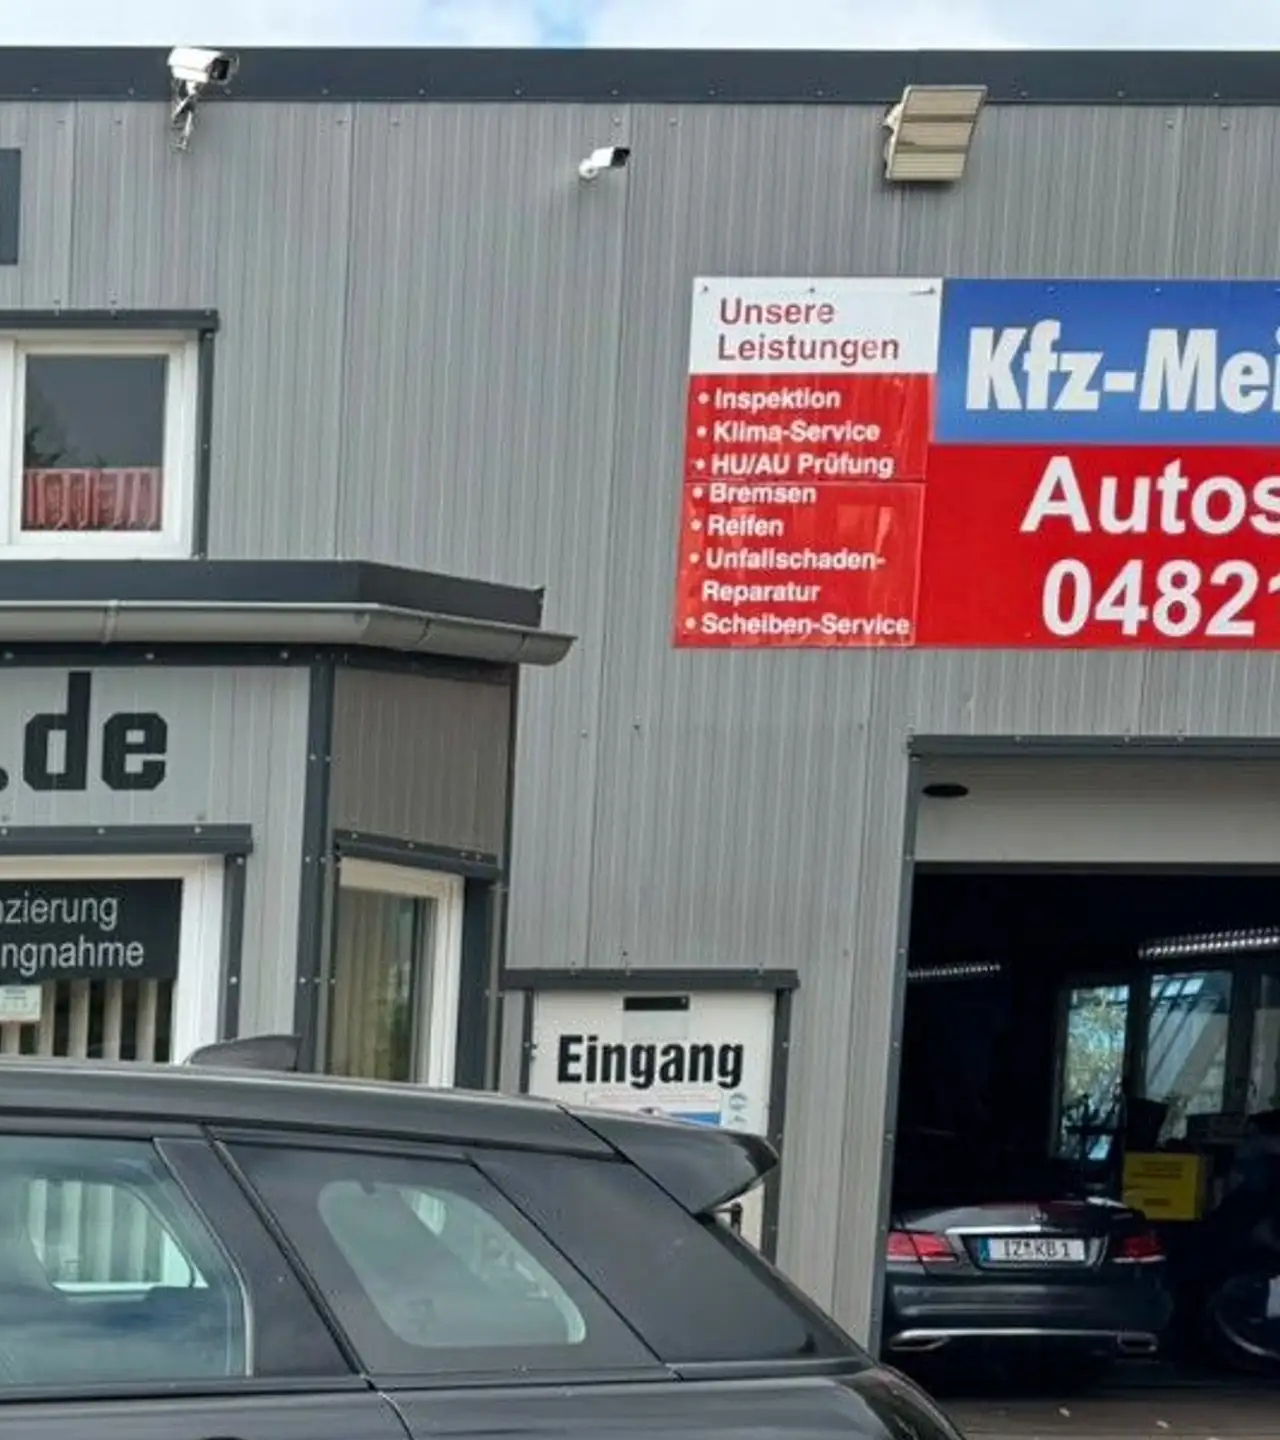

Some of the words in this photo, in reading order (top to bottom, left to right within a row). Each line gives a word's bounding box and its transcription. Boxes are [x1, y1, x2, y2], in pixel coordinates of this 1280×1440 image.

[719, 298, 836, 326] Unsere
[717, 335, 899, 367] Leistungen
[714, 387, 841, 411] Inspektion
[713, 421, 881, 443] Klima-Service
[712, 455, 790, 476] HU/AU
[797, 453, 895, 478] Prüfung
[709, 483, 816, 504] Bremsen
[708, 515, 783, 537] Reifen
[706, 549, 886, 571] Unfallschaden-
[702, 581, 821, 605] Reparatur
[702, 614, 910, 637] Scheiben-Service
[557, 1034, 743, 1088] Eingang
